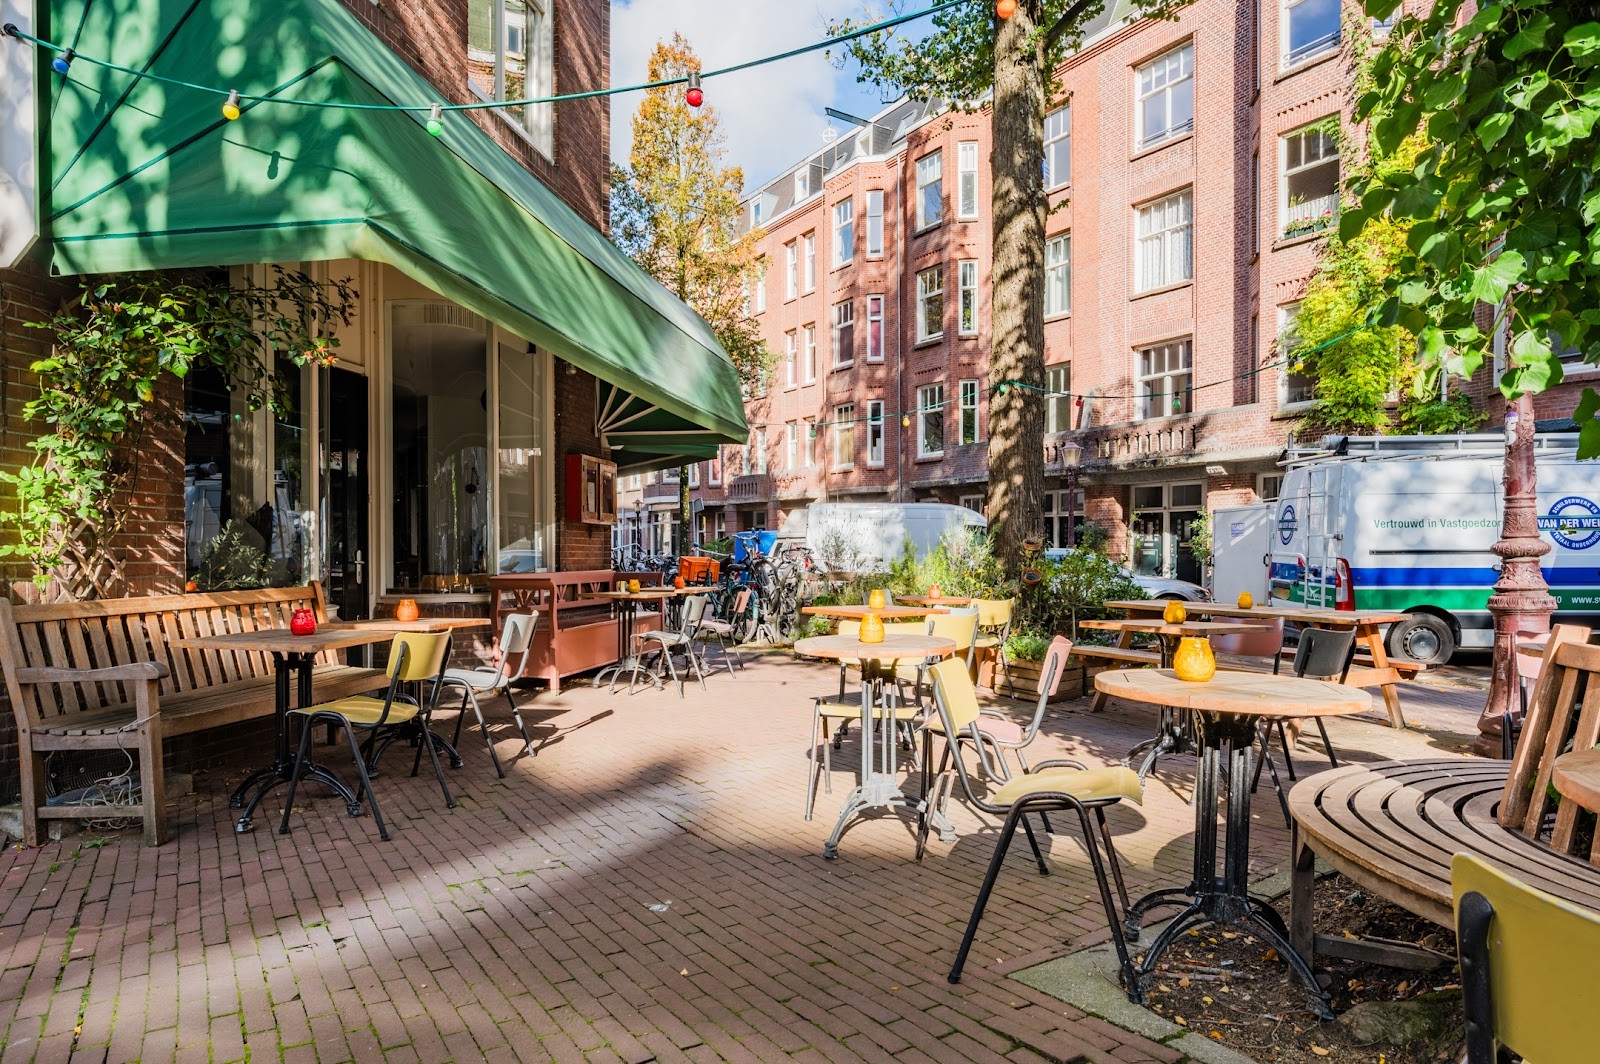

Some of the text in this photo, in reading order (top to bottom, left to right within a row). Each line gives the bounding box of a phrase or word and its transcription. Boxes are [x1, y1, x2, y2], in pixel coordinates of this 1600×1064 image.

[1552, 498, 1592, 514] SCHILDERWERK
[1374, 519, 1502, 530] Vertrouwd in Vastgoedzor
[1538, 518, 1557, 528] VAN
[1560, 518, 1580, 528] DER
[1553, 531, 1570, 547] TOTAAL
